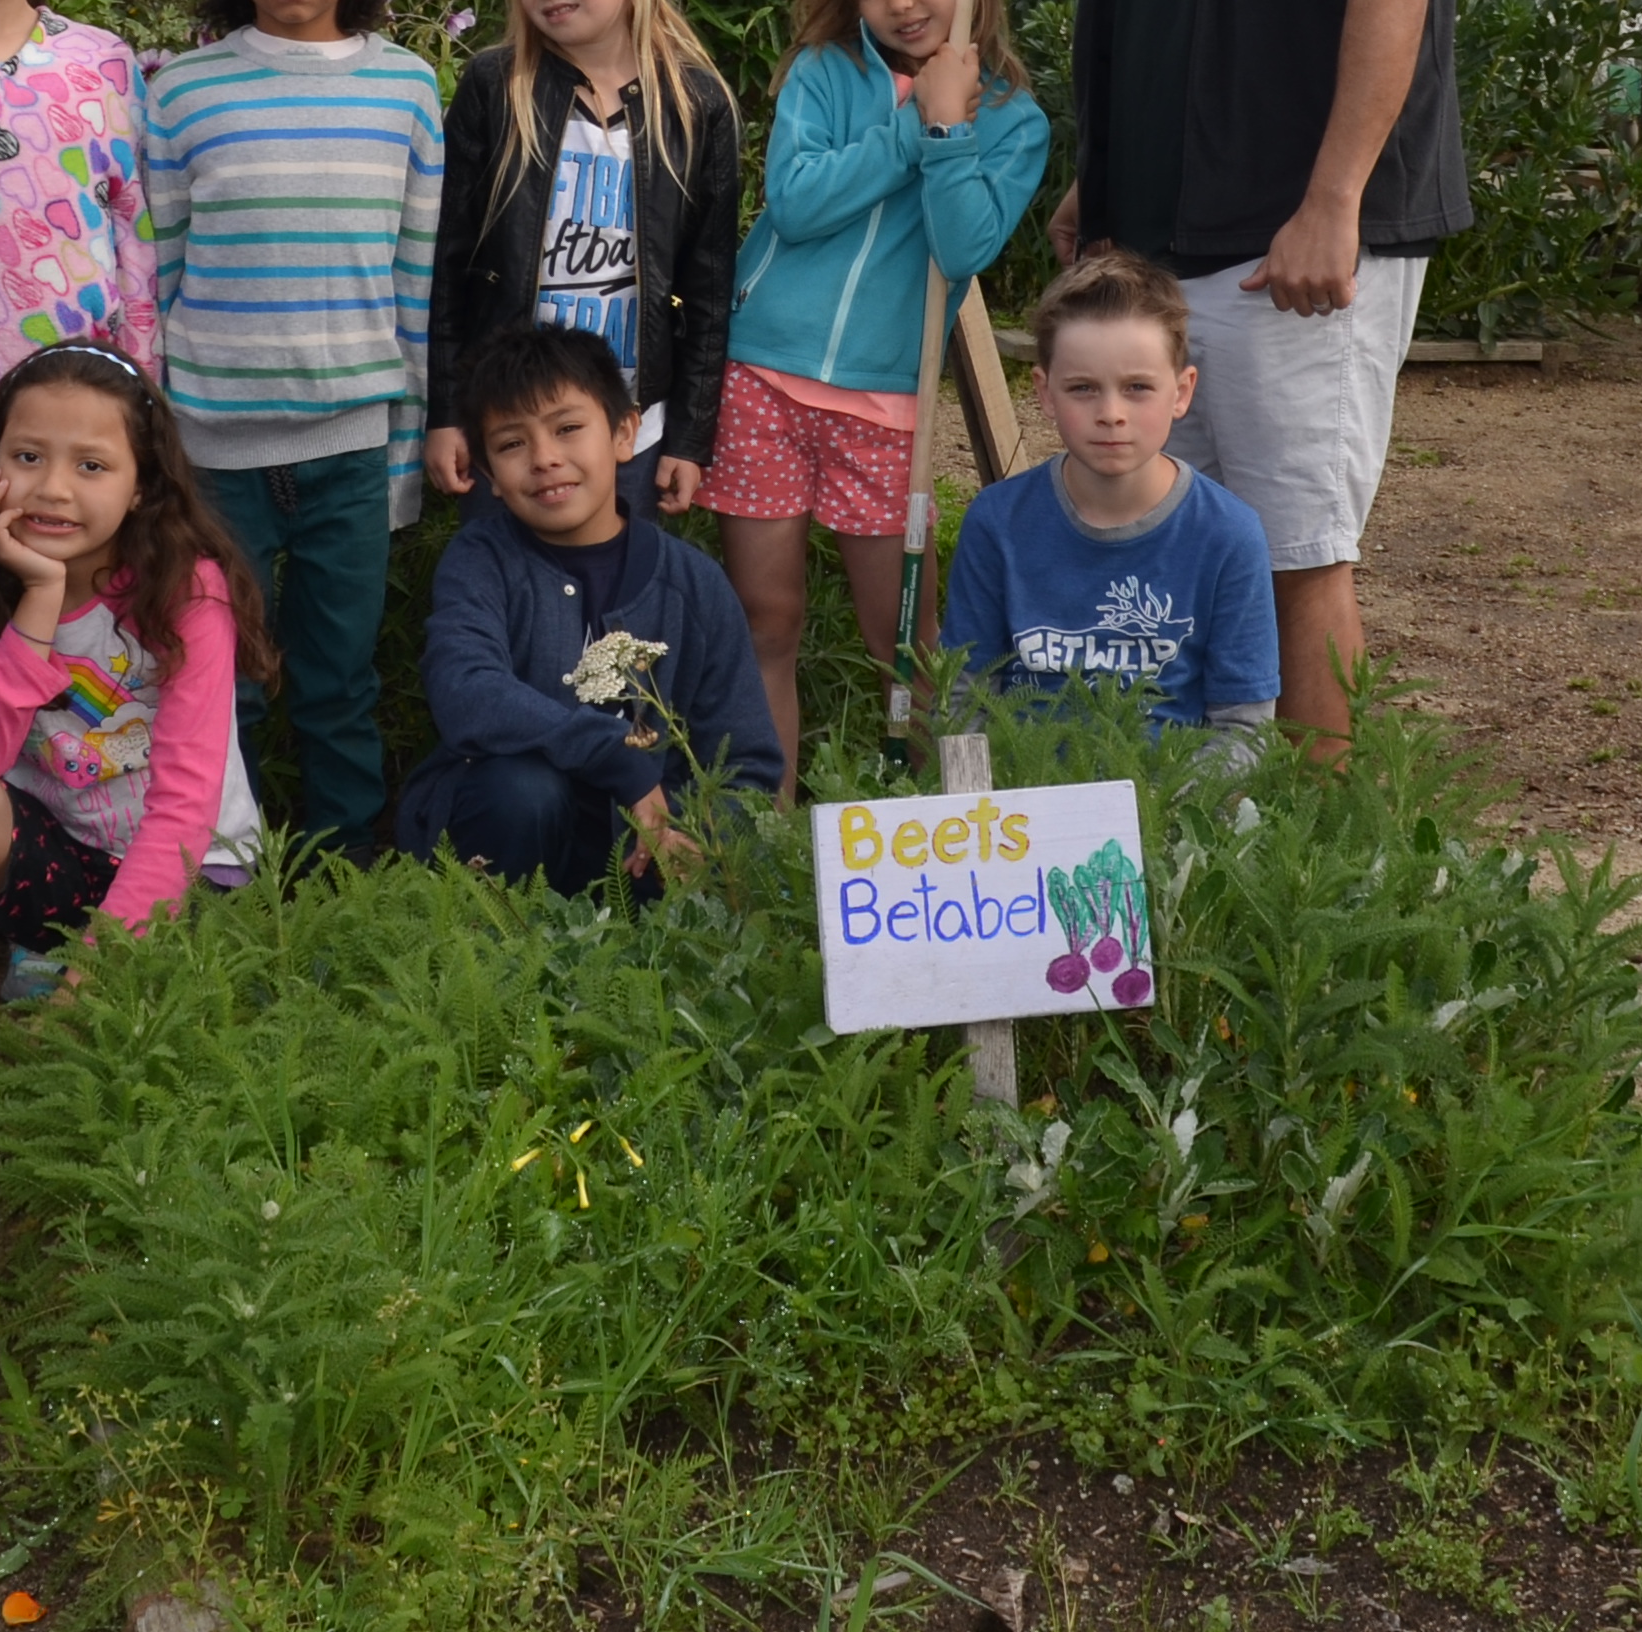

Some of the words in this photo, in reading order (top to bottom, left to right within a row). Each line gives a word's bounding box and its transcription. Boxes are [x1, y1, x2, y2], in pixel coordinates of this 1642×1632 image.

[547, 149, 634, 232] FTBA
[543, 218, 636, 278] ftba
[1018, 631, 1084, 673] GET
[1084, 634, 1178, 672] WILD
[839, 797, 1030, 871] Beets
[839, 866, 1046, 945] Betabel
